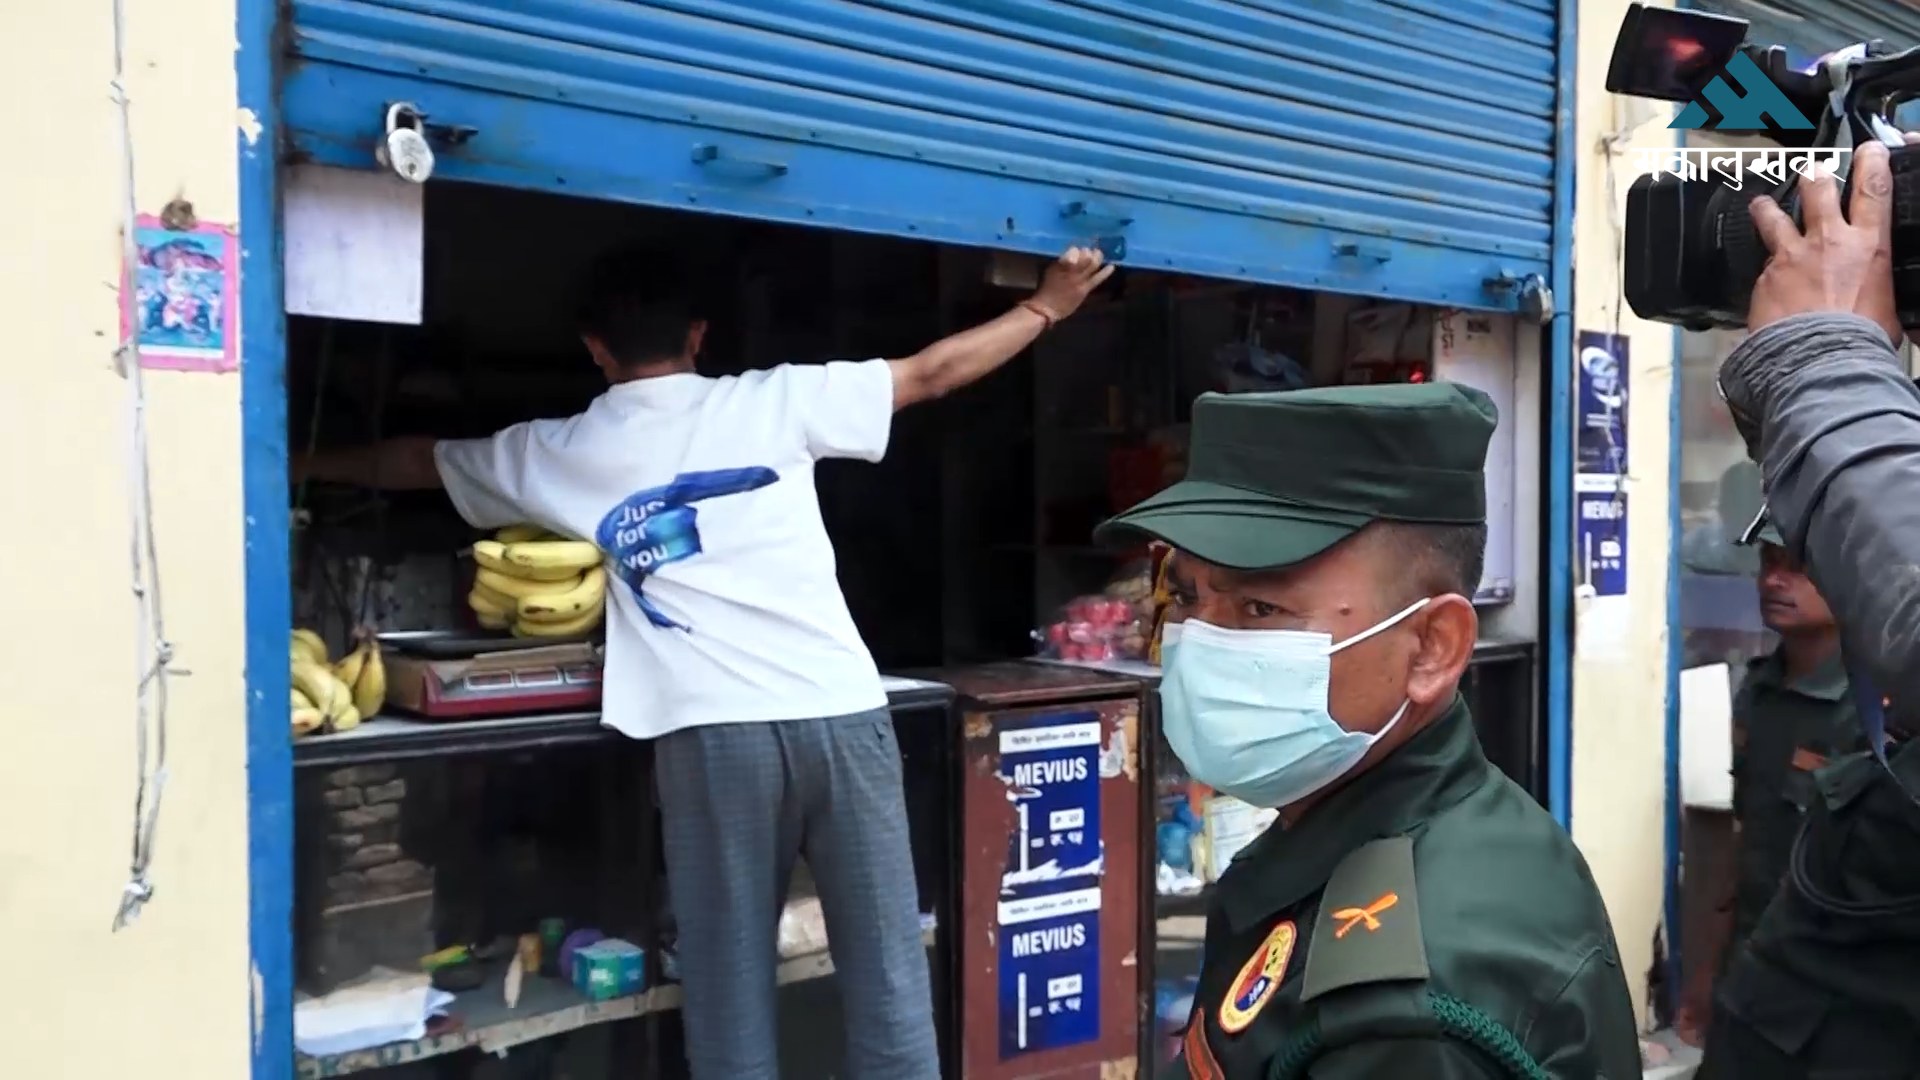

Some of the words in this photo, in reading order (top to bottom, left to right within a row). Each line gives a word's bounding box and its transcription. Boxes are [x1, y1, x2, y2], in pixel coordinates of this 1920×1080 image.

[615, 521, 648, 548] for
[1014, 756, 1088, 788] MEVIUS
[1012, 922, 1087, 958] MEVIUS
